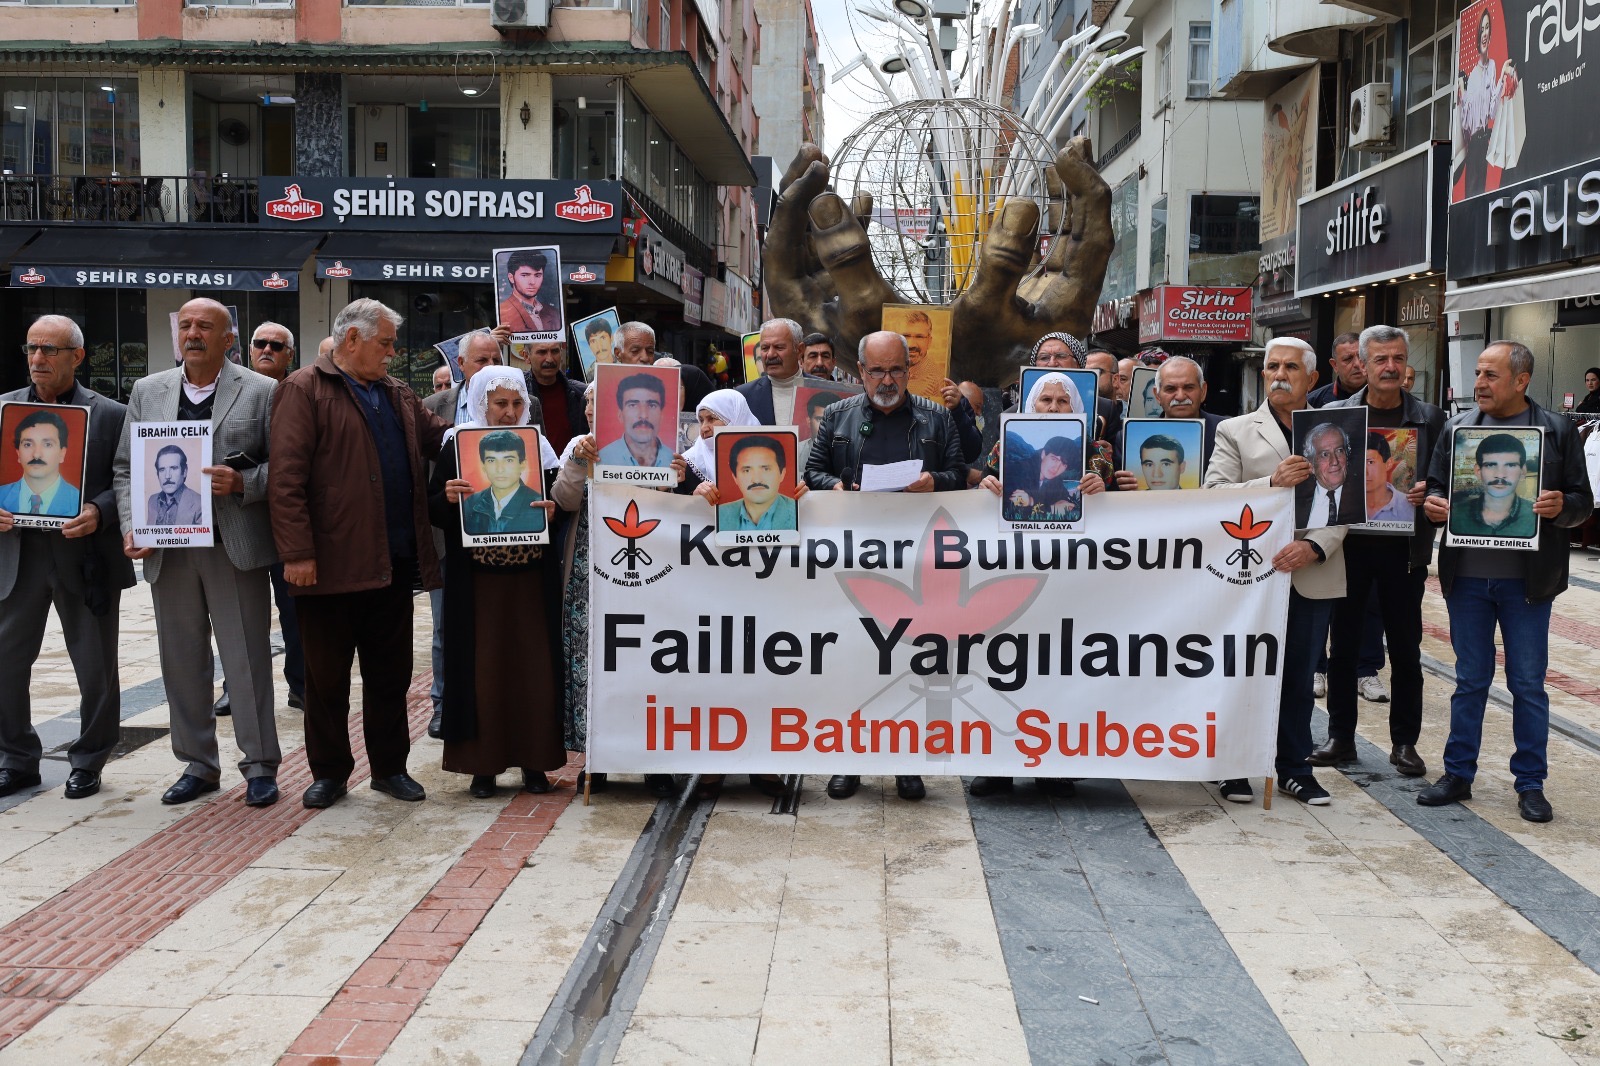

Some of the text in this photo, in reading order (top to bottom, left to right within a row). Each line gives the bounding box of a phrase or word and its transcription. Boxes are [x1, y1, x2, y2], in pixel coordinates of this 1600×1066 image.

[272, 201, 317, 216] şenpiliç
[333, 181, 544, 223] ŞEHİR SOFRASI
[562, 201, 606, 218] şenpiliç
[1325, 186, 1383, 256] stilife
[76, 268, 233, 286] ŞEHİR SOFRASI
[383, 263, 445, 279] ŞEHİR
[1180, 290, 1235, 309] Şirin
[1168, 308, 1246, 321] Collection
[1401, 295, 1430, 322] stilife
[137, 425, 209, 438] İBRAHİM ÇELİK
[602, 470, 669, 481] Eset GÖKTAYI
[173, 526, 211, 534] GÖZALTINDA
[1012, 522, 1073, 530] İSMAİL AĞAYA
[156, 537, 190, 545] KAYBEDİLDİ
[472, 535, 508, 544] M.ŞİRİN
[736, 534, 781, 544] İSA GÖK
[1452, 538, 1533, 548] MAHMUT DEMİREL
[680, 523, 1202, 580] Kayıplar Bulunsun
[593, 563, 674, 587] NSAN HAKLARI DERNEĞİ
[1206, 563, 1276, 586] İNSAN HAKLARI DERNE
[604, 613, 1280, 692] Failler Yargılansın
[644, 694, 1218, 768] İHD Batman Şubesi
